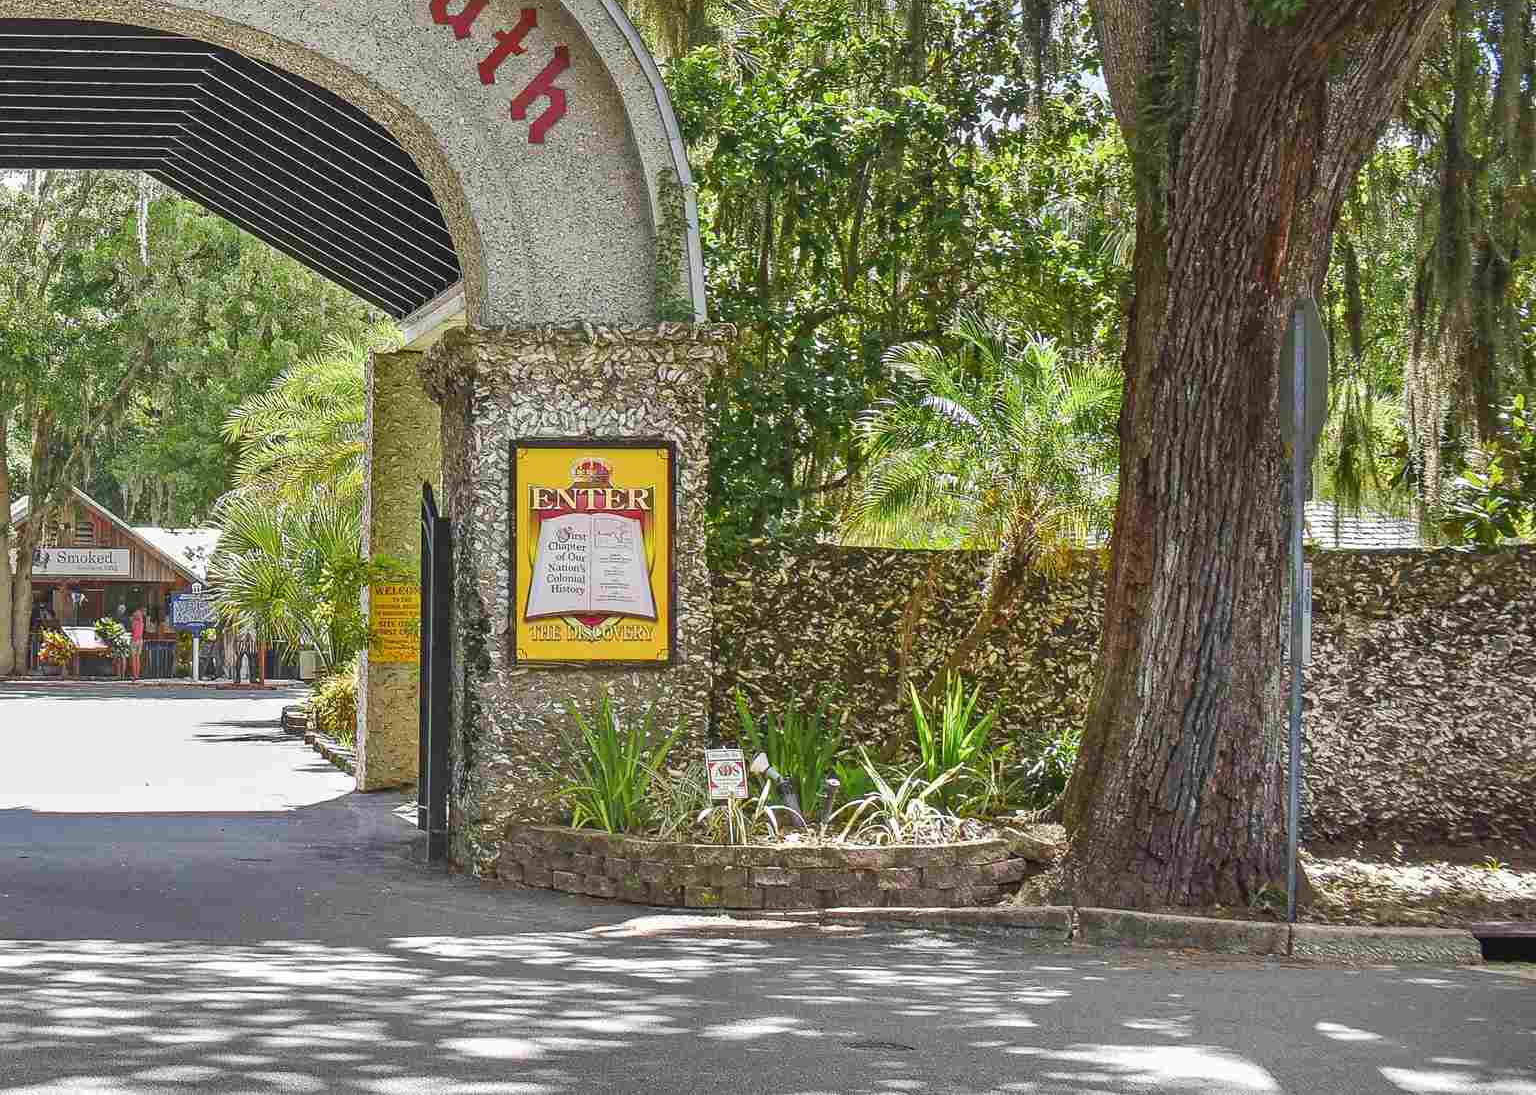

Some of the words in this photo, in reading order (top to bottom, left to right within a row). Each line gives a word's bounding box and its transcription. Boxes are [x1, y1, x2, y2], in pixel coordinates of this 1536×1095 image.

[532, 488, 652, 510] ENTER
[547, 541, 587, 554] Chapter
[56, 550, 113, 564] Smoked
[555, 552, 565, 562] of
[567, 552, 586, 563] Our
[547, 562, 586, 574] Nation's
[545, 573, 586, 584] Colonial
[550, 584, 586, 596] History
[529, 625, 562, 642] THE
[566, 625, 657, 642] DISCOVERY
